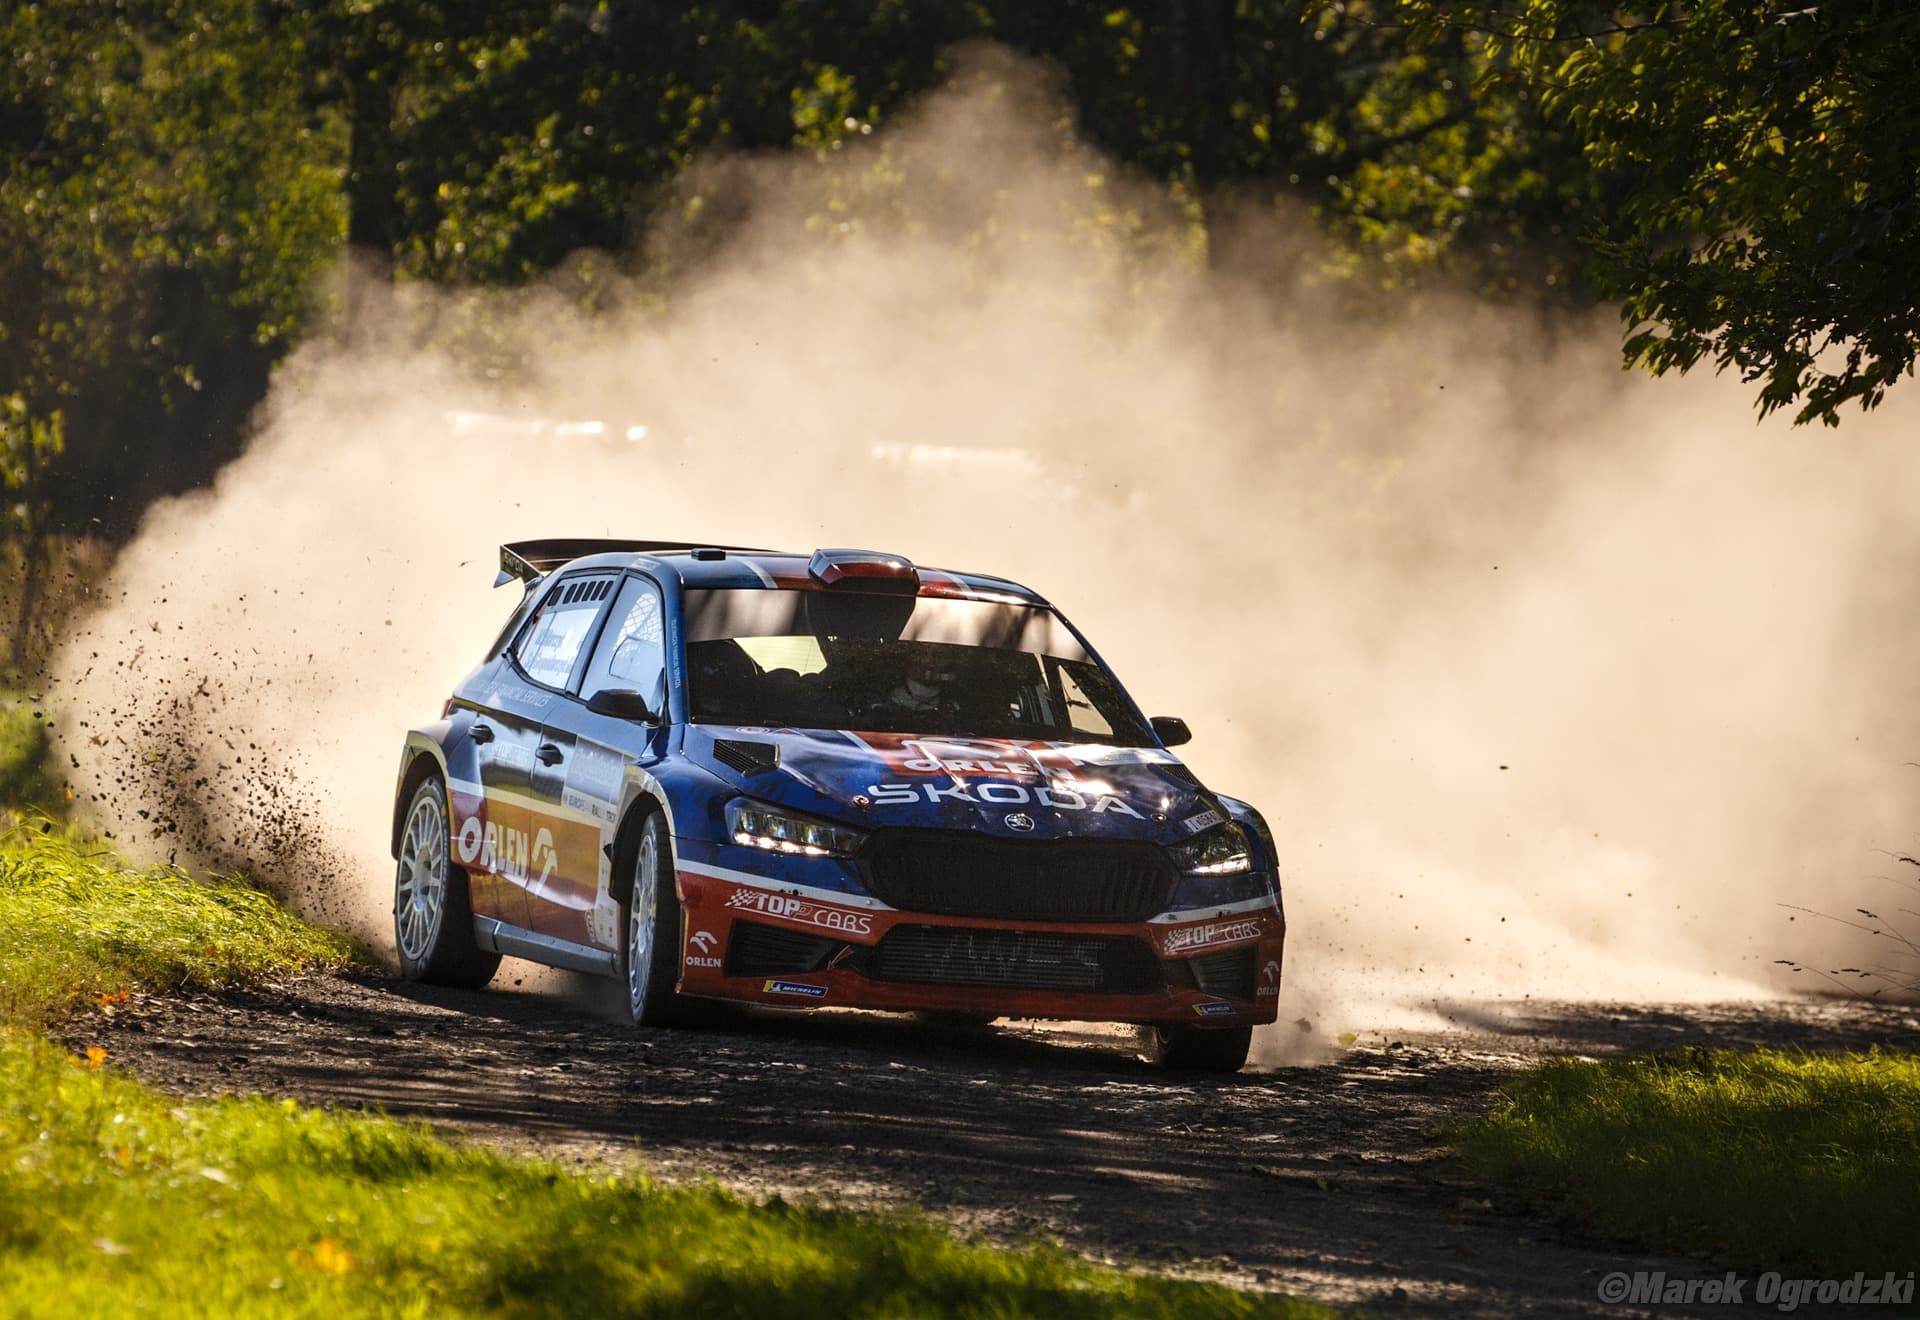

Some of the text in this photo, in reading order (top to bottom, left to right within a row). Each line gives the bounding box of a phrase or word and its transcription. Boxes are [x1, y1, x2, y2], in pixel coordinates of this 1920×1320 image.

[903, 758, 1077, 781] ORLEN
[458, 816, 529, 878] ORLEN
[756, 892, 871, 935] TOP CARS
[1184, 921, 1261, 946] TOP CARS
[685, 956, 722, 968] ORLEN
